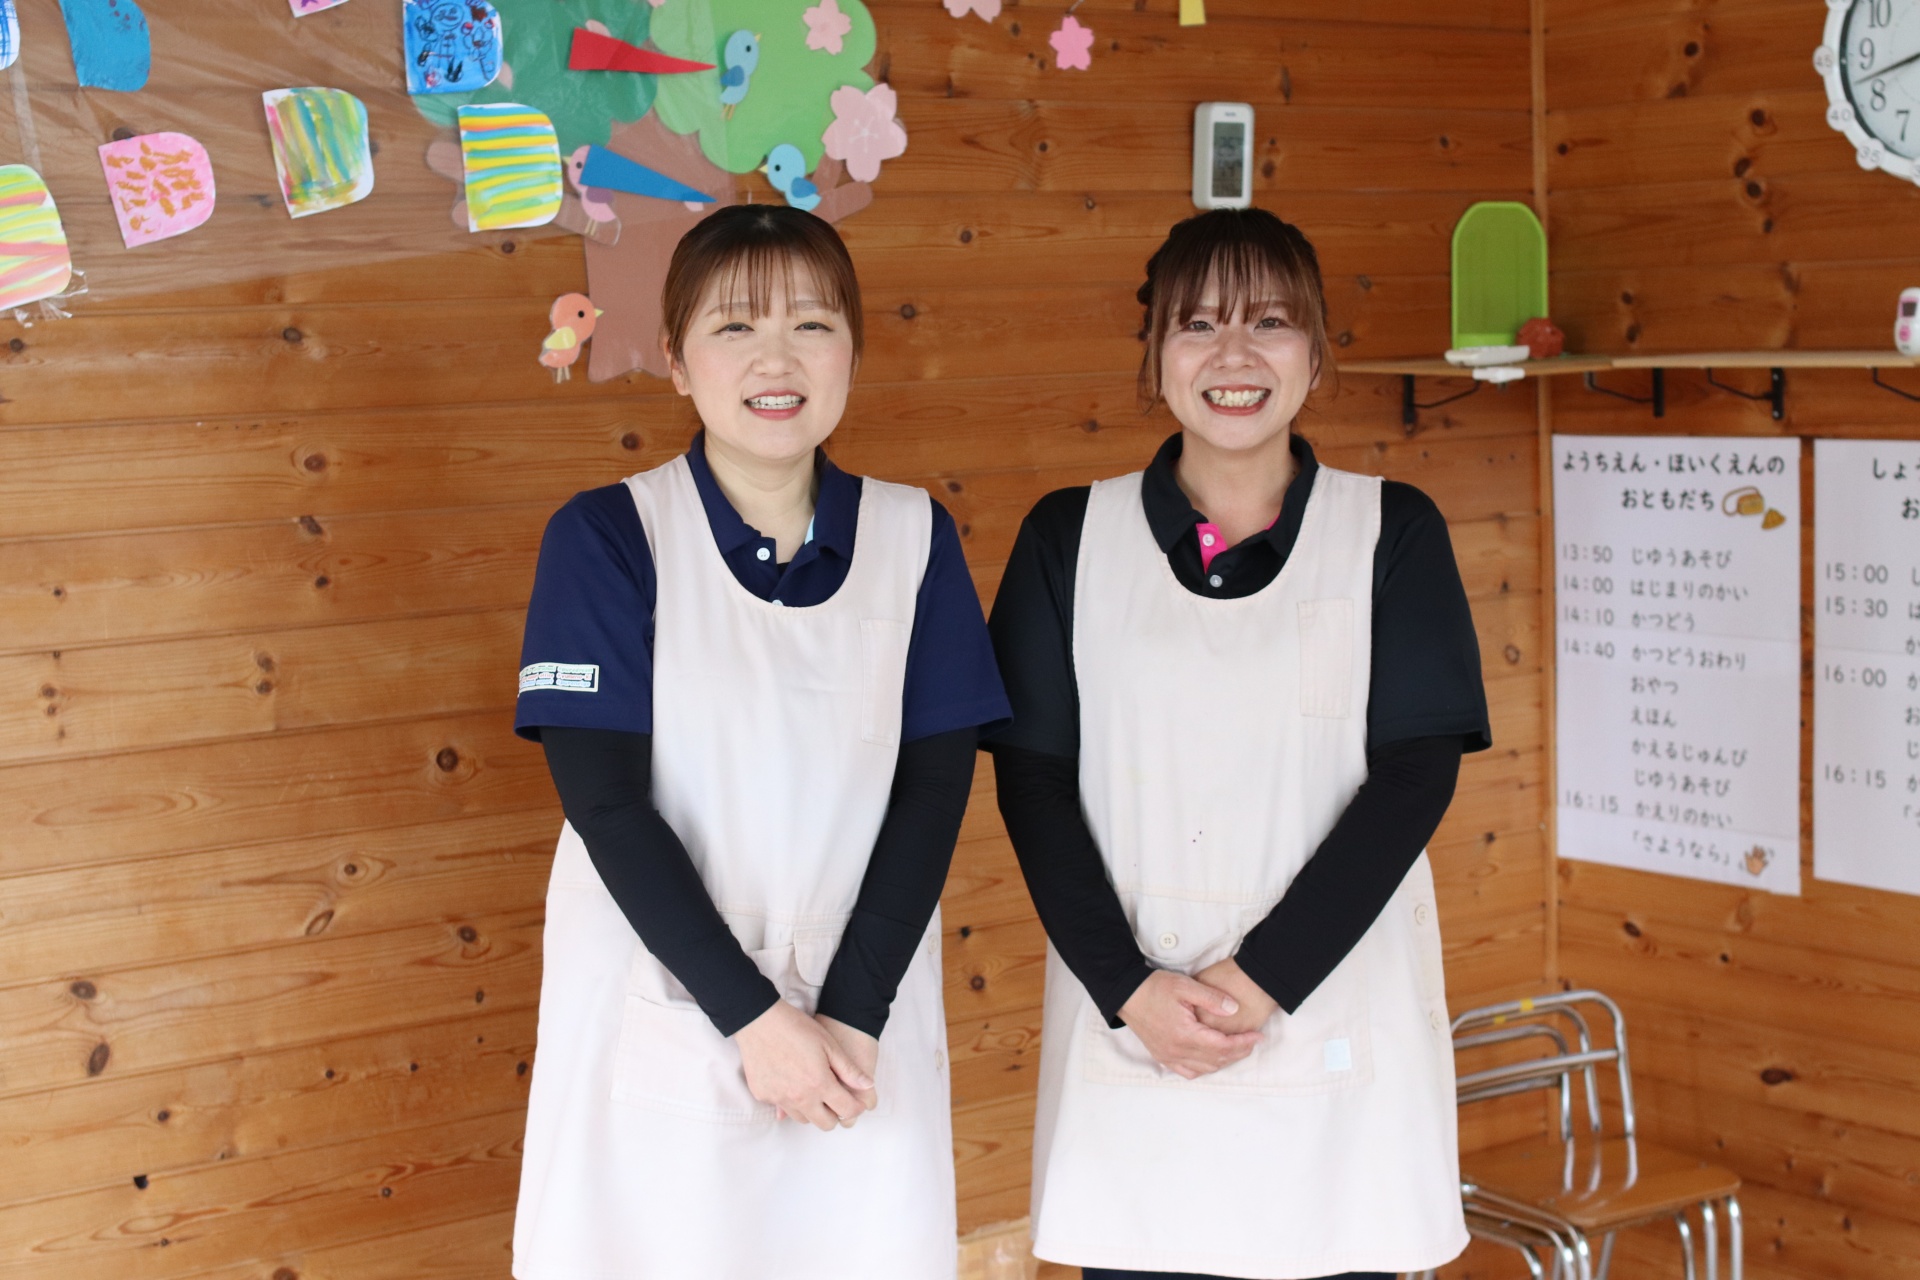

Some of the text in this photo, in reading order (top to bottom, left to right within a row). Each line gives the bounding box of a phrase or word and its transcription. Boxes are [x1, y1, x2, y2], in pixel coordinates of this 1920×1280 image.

[1868, 0, 1891, 28] 10
[1815, 53, 1833, 69] 45
[1859, 37, 1875, 70] 9
[1870, 78, 1887, 112] 8
[1830, 109, 1851, 122] 40
[1896, 109, 1911, 142] 7
[1860, 146, 1881, 164] 35
[1563, 451, 1785, 476] ようちえん・ほいくえんの
[1621, 488, 1715, 512] おともだち
[1901, 496, 1920, 521] お
[1562, 543, 1613, 564] 13:50
[1826, 562, 1889, 584] 15:00
[1563, 575, 1748, 601] 14:00 はじまりのかい
[1564, 607, 1695, 632] 14:10 かつどう
[1826, 596, 1888, 619] 15:30
[1564, 639, 1747, 671] 14:40 かつどうおわり
[1631, 676, 1679, 695] おやつ
[1825, 665, 1887, 688] 16:00
[1631, 706, 1676, 728] えほん
[1825, 765, 1886, 789] 16:15
[1565, 790, 1732, 829] 16:15 かえりのかい
